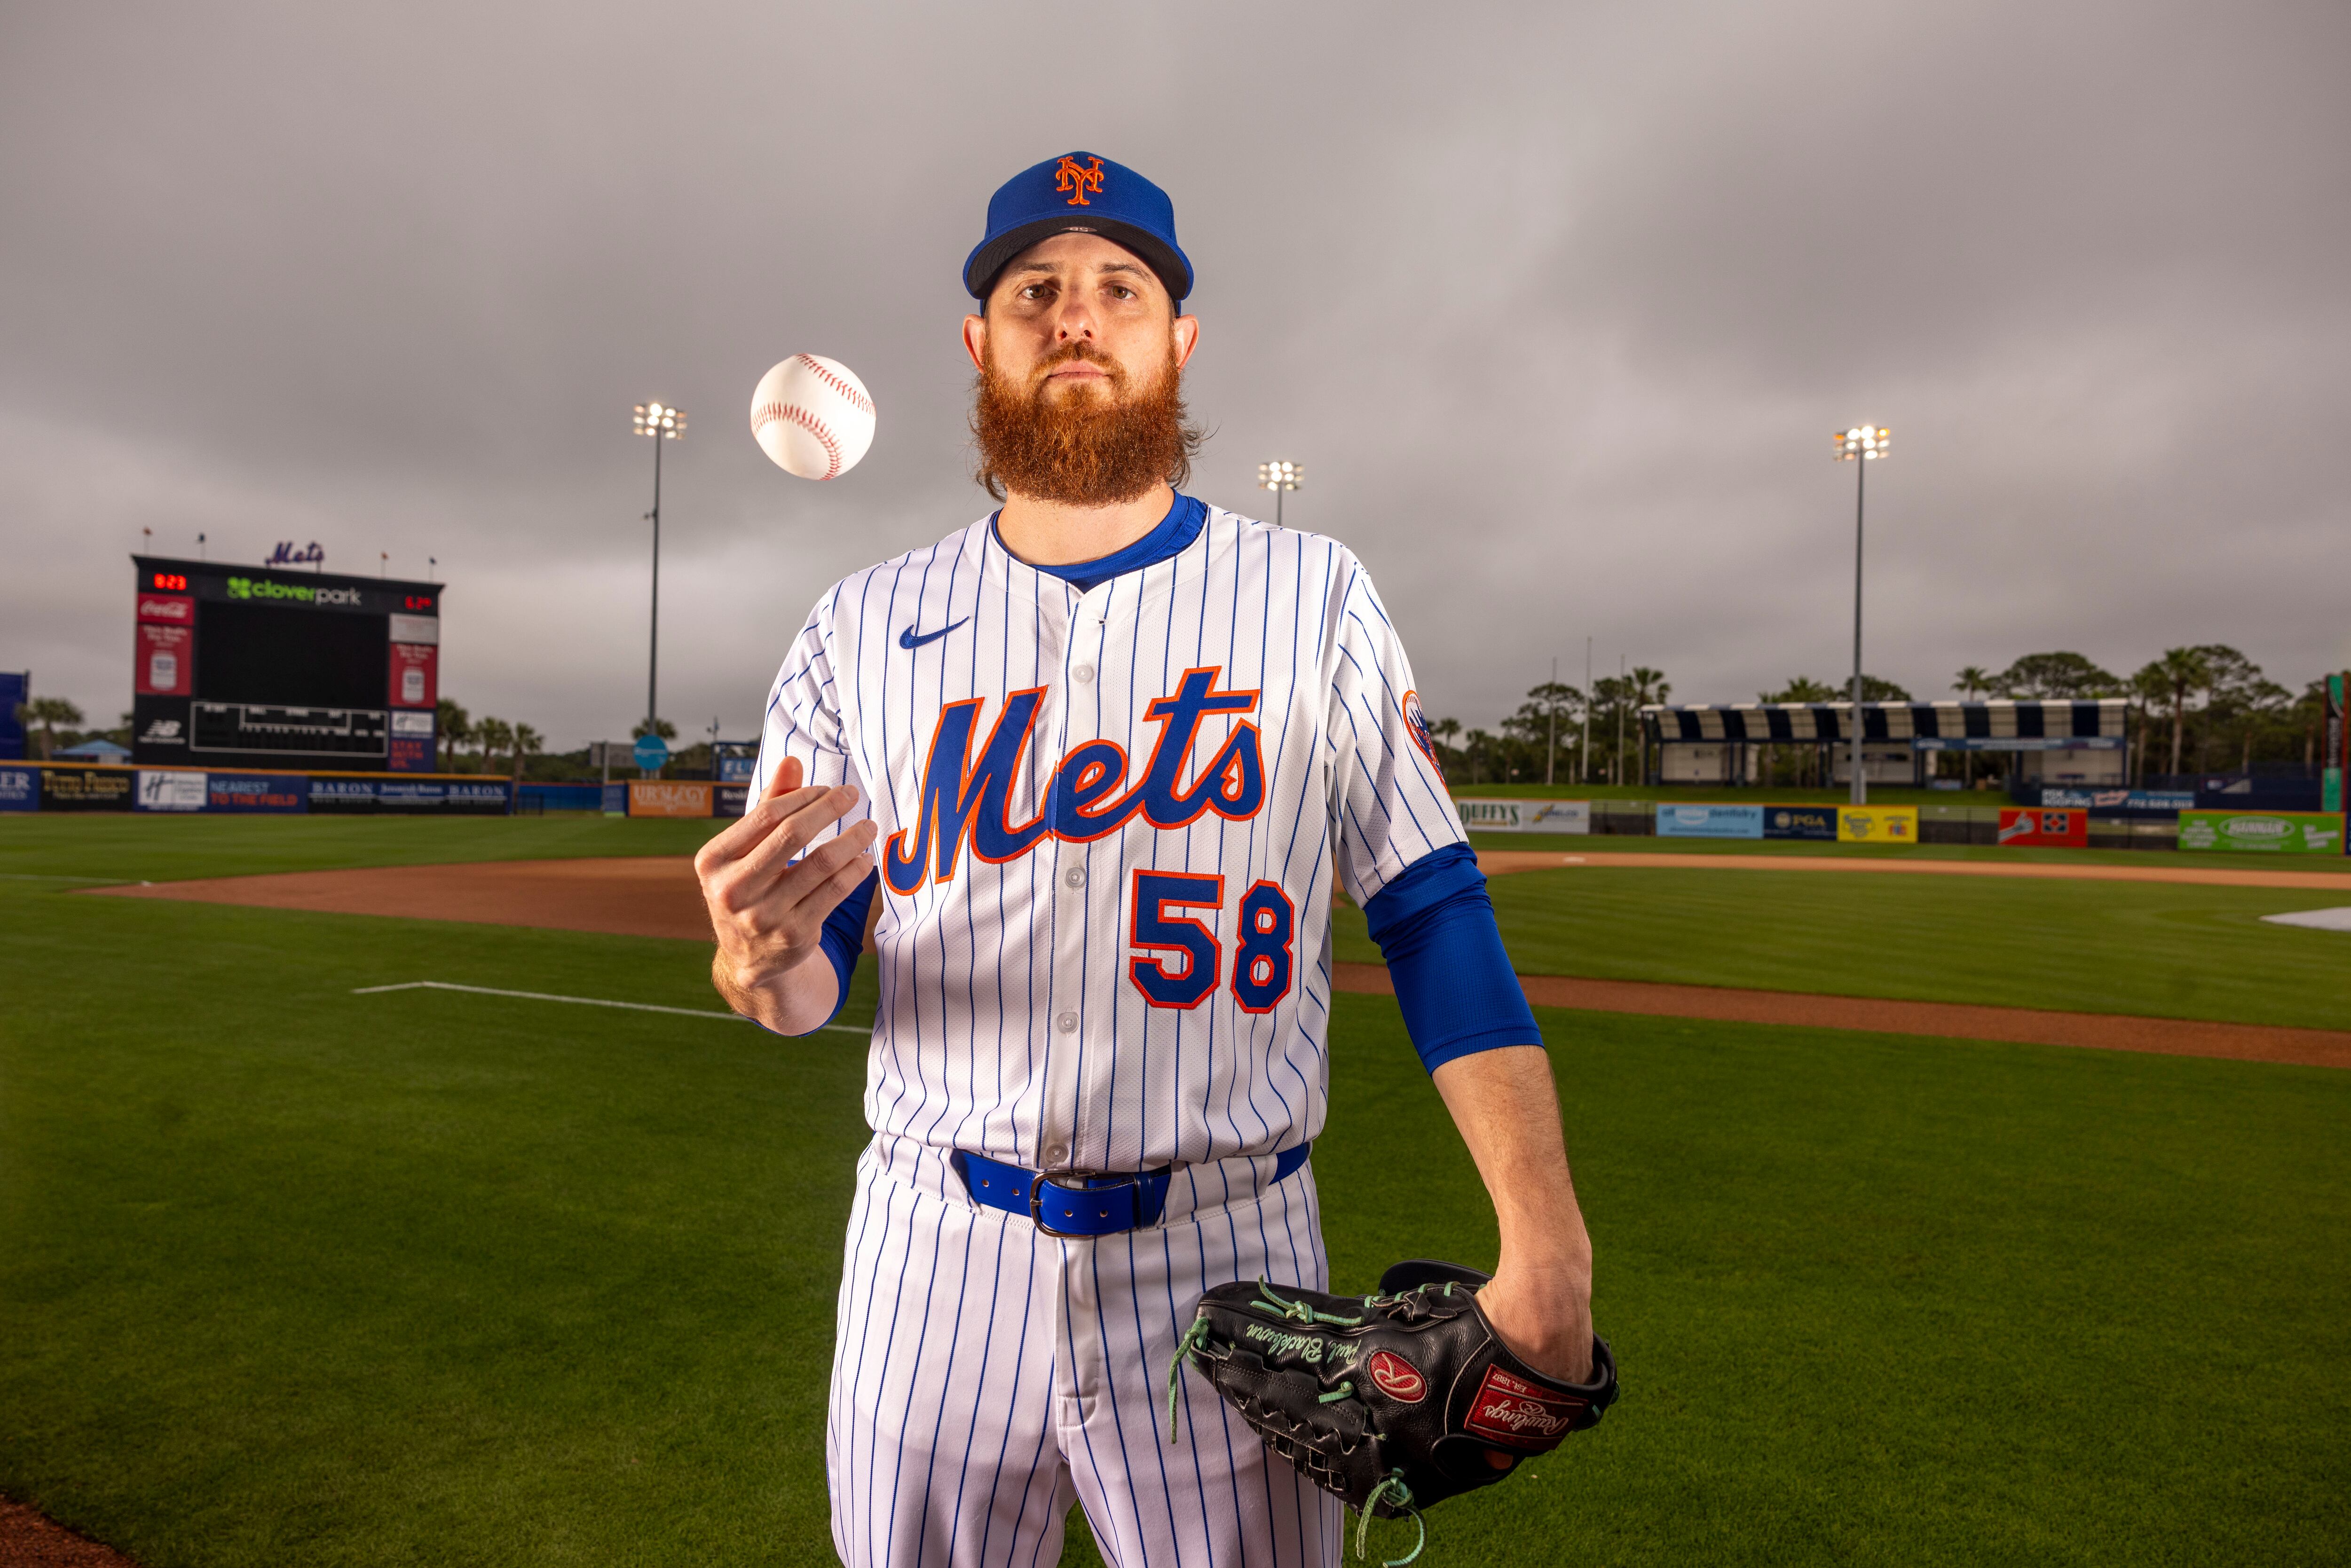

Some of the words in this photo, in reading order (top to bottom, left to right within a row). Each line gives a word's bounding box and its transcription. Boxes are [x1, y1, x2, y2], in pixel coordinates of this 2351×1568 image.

[1056, 156, 1104, 205] NY
[265, 542, 324, 564] Mets
[210, 780, 271, 793] NEAREST
[312, 781, 373, 794] BARON
[449, 784, 505, 795] BARON
[884, 666, 1265, 896] Mets
[211, 793, 230, 805] TO
[231, 793, 257, 806] THE
[259, 794, 299, 807] FIELD
[1791, 814, 1826, 827] PGA
[1129, 869, 1294, 1014] 58
[1246, 1324, 1323, 1363] Blackburn
[1327, 1339, 1361, 1365] Paul
[1492, 1374, 1511, 1384] 1887
[1483, 1400, 1569, 1435] Rawlings
